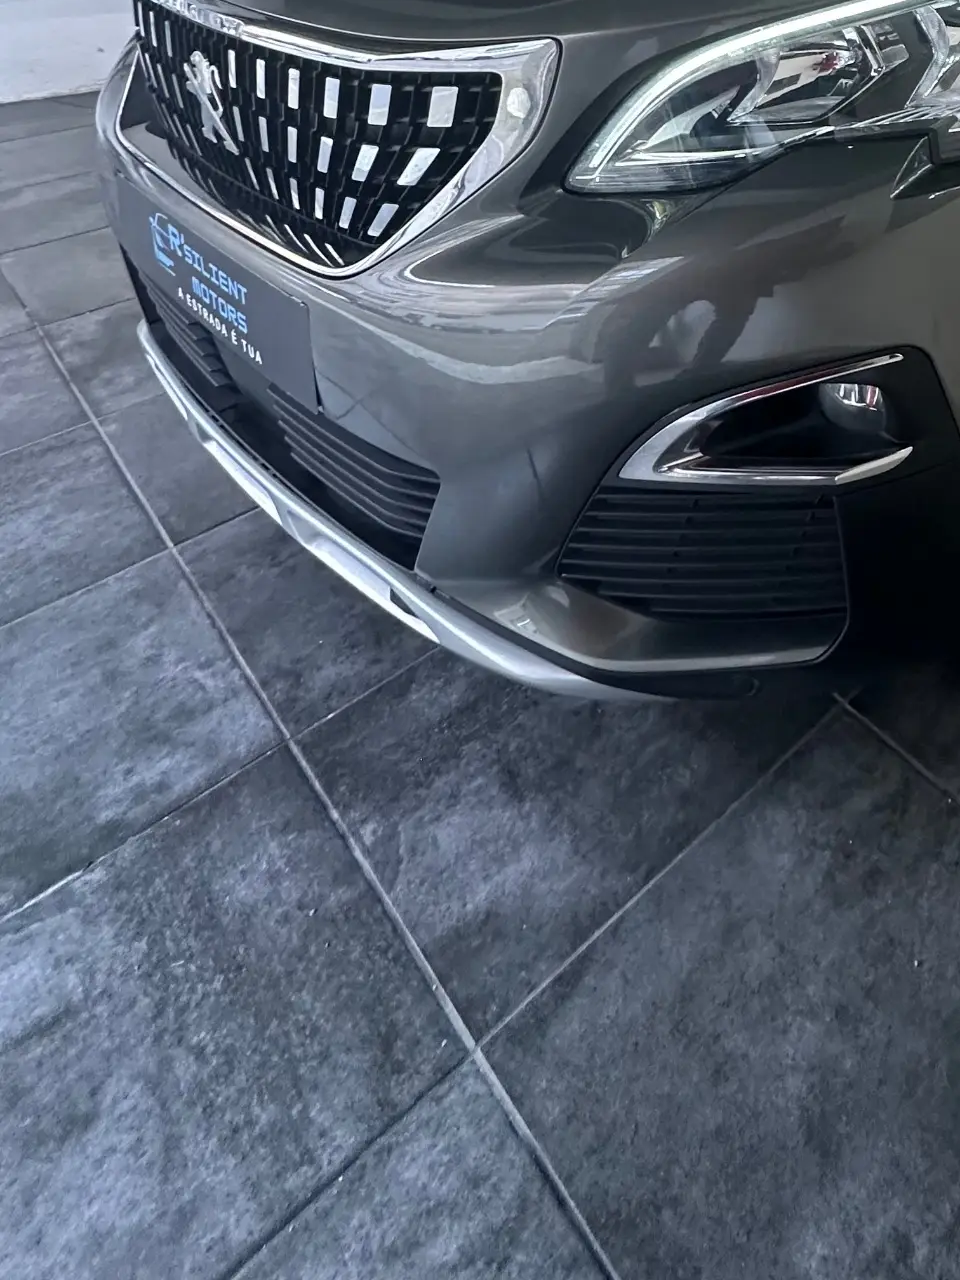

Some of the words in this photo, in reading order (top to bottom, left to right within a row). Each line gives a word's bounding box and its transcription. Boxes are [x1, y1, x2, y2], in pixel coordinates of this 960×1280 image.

[178, 287, 185, 300] A
[186, 294, 228, 337] ESTRADA
[231, 329, 238, 345] É
[241, 338, 263, 365] TUA
[192, 276, 248, 334] MOTORS
